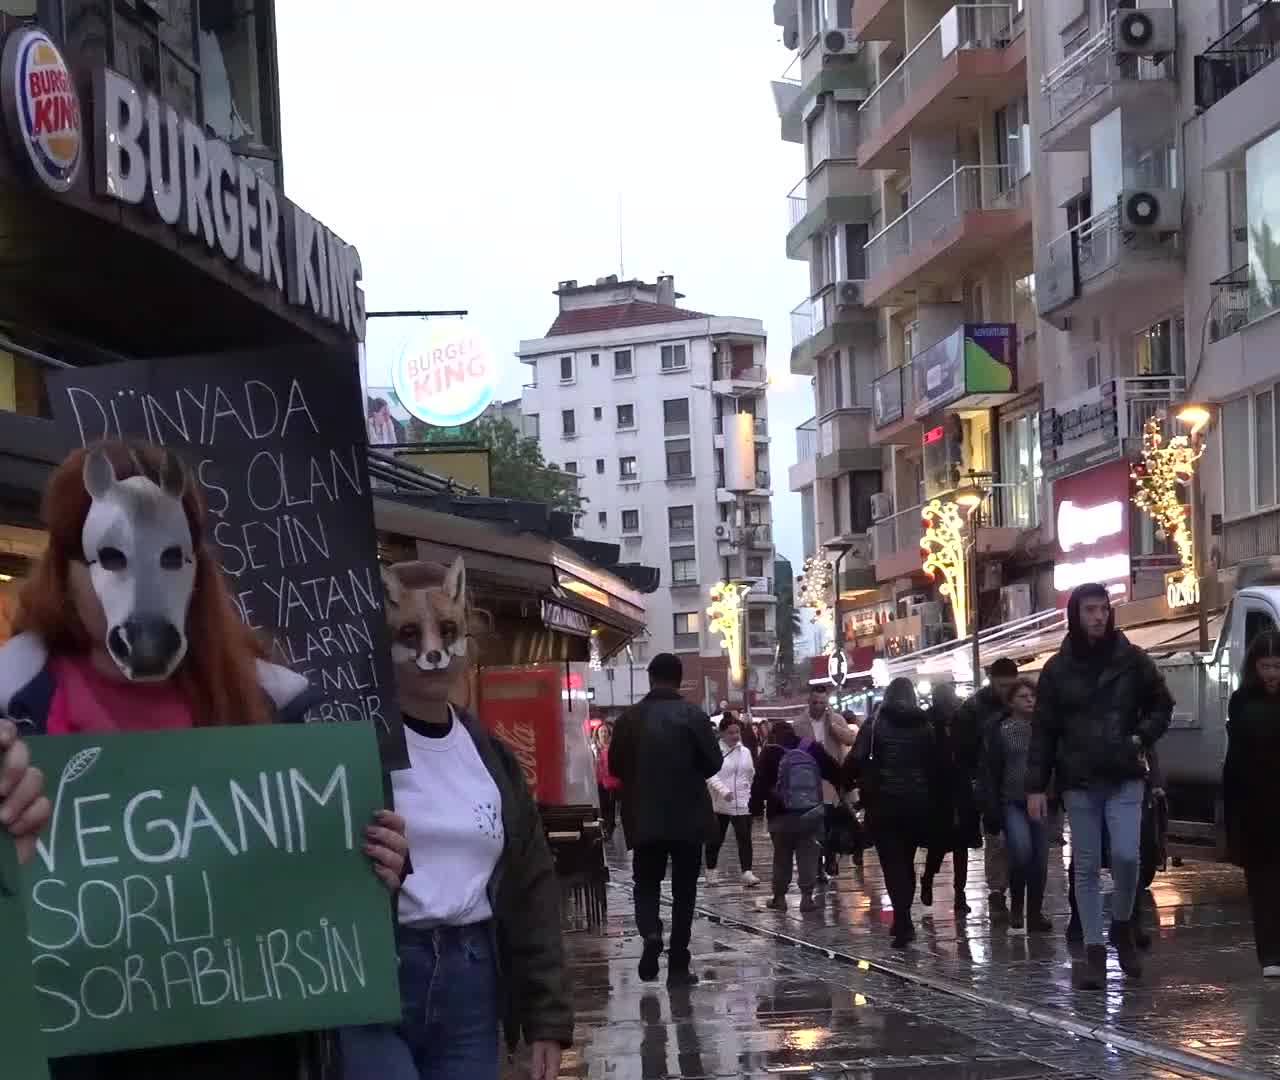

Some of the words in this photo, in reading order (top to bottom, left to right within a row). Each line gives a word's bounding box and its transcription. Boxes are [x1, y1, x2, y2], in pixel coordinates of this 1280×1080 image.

[104, 67, 283, 291] BURGER
[290, 205, 366, 342] KING
[67, 378, 319, 448] DÜNYADA
[247, 445, 362, 512] OLAN
[35, 762, 355, 873] VEGANIM
